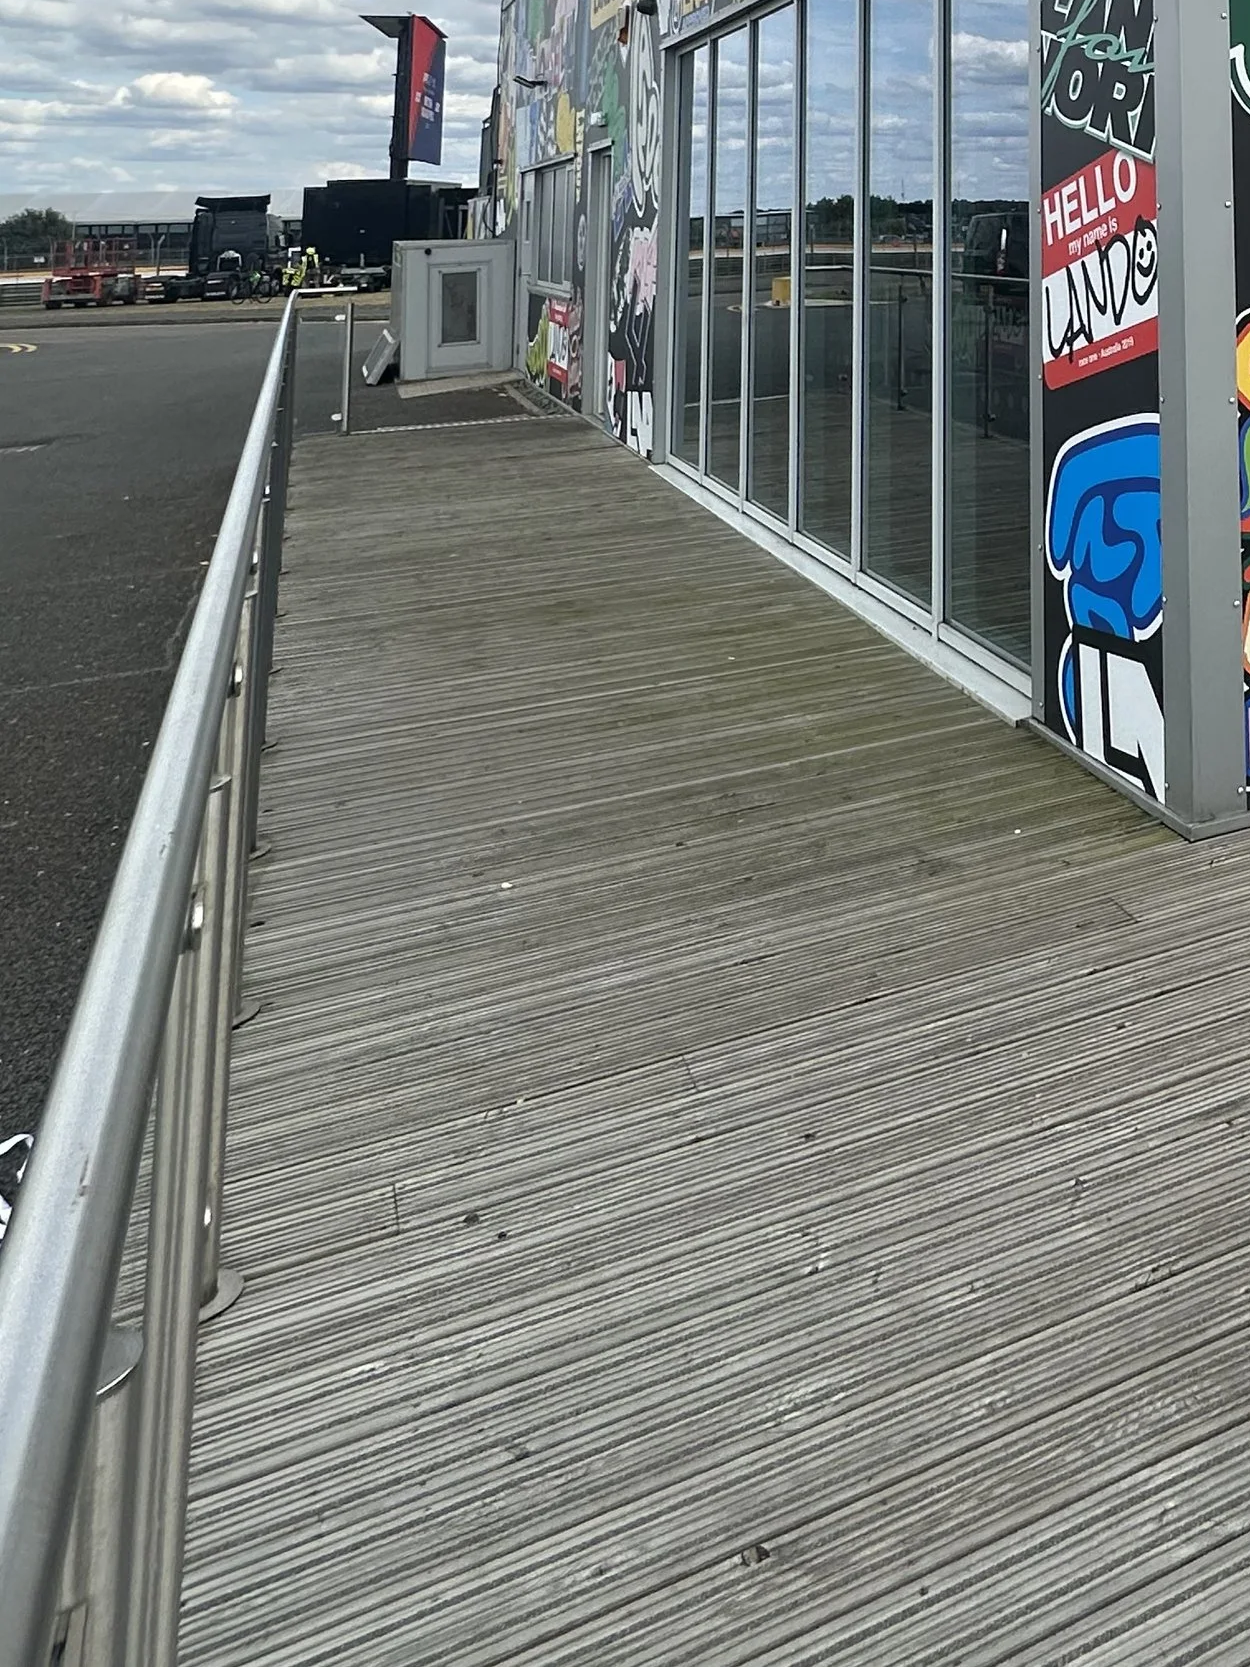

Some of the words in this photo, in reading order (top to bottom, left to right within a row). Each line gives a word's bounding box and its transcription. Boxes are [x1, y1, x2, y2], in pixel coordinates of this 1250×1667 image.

[1042, 150, 1138, 247] HELLO
[1067, 240, 1082, 256] my
[1083, 223, 1108, 248] name
[1108, 215, 1118, 233] is
[1045, 214, 1159, 364] LANDO
